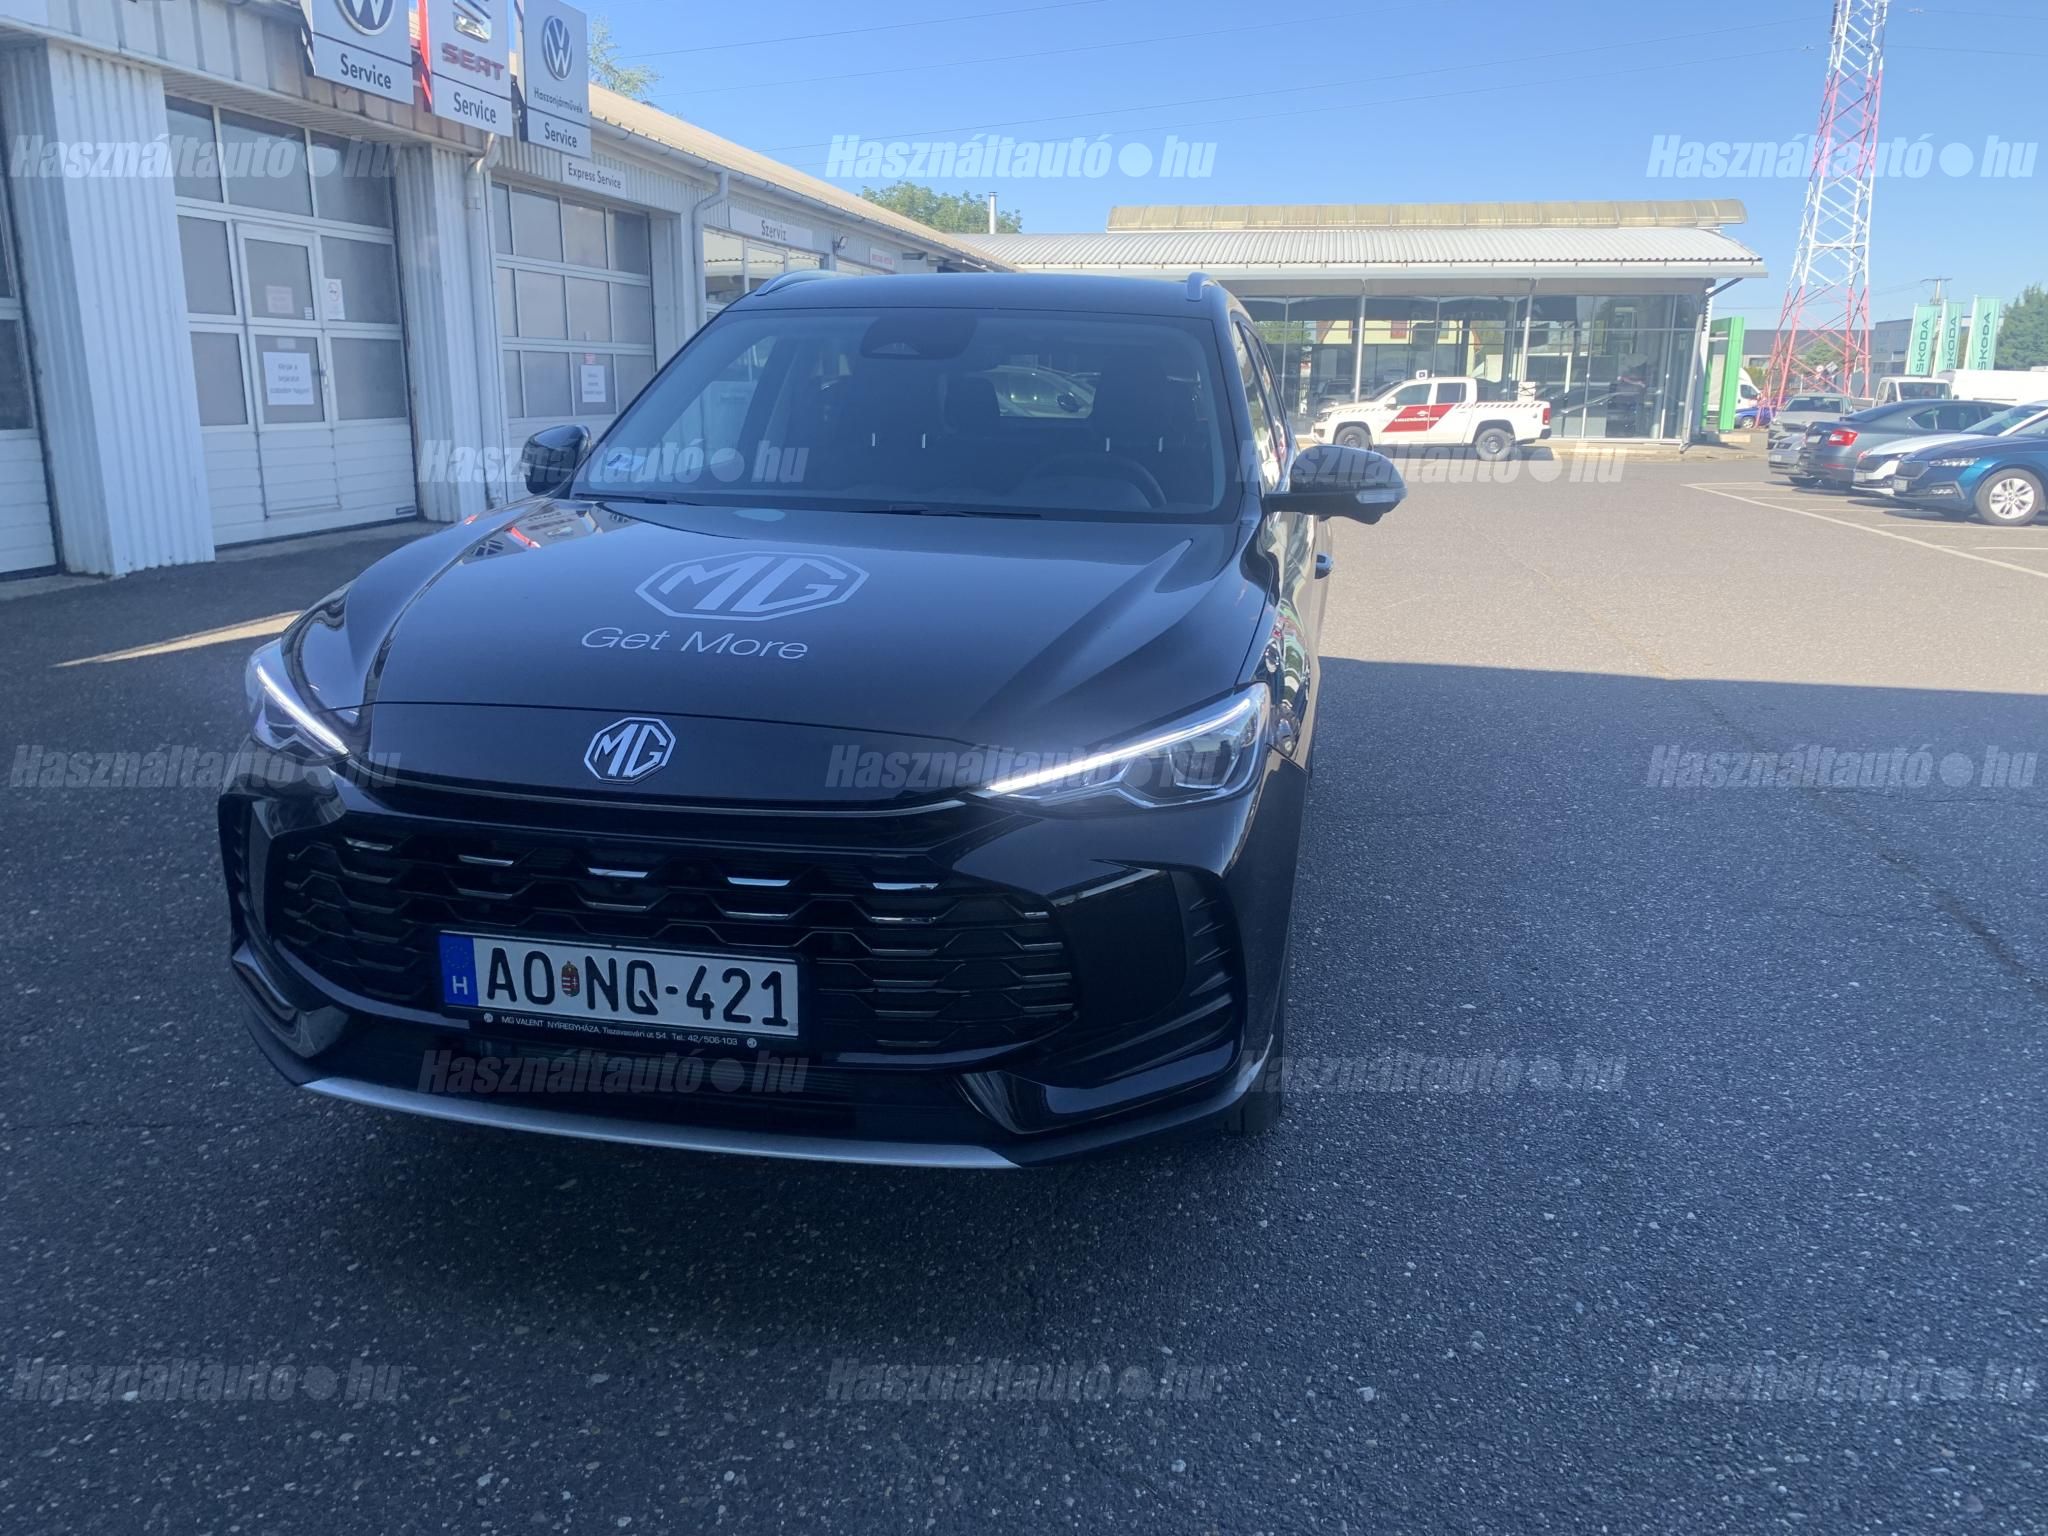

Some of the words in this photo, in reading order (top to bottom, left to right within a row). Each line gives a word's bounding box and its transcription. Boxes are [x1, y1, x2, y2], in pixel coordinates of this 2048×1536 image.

[340, 53, 392, 90] Service
[441, 42, 504, 80] SEAT
[454, 91, 497, 124] Service
[544, 122, 578, 148] Service
[568, 162, 596, 182] Express
[597, 169, 622, 189] Service
[761, 219, 787, 241] Szerviz
[654, 554, 848, 613] MG
[581, 626, 670, 650] Get
[680, 631, 809, 660] More
[592, 722, 668, 778] MG
[452, 975, 468, 995] H
[501, 1016, 515, 1025] MG
[516, 1018, 544, 1028] VALENT
[687, 1035, 738, 1046] 42/506-103
